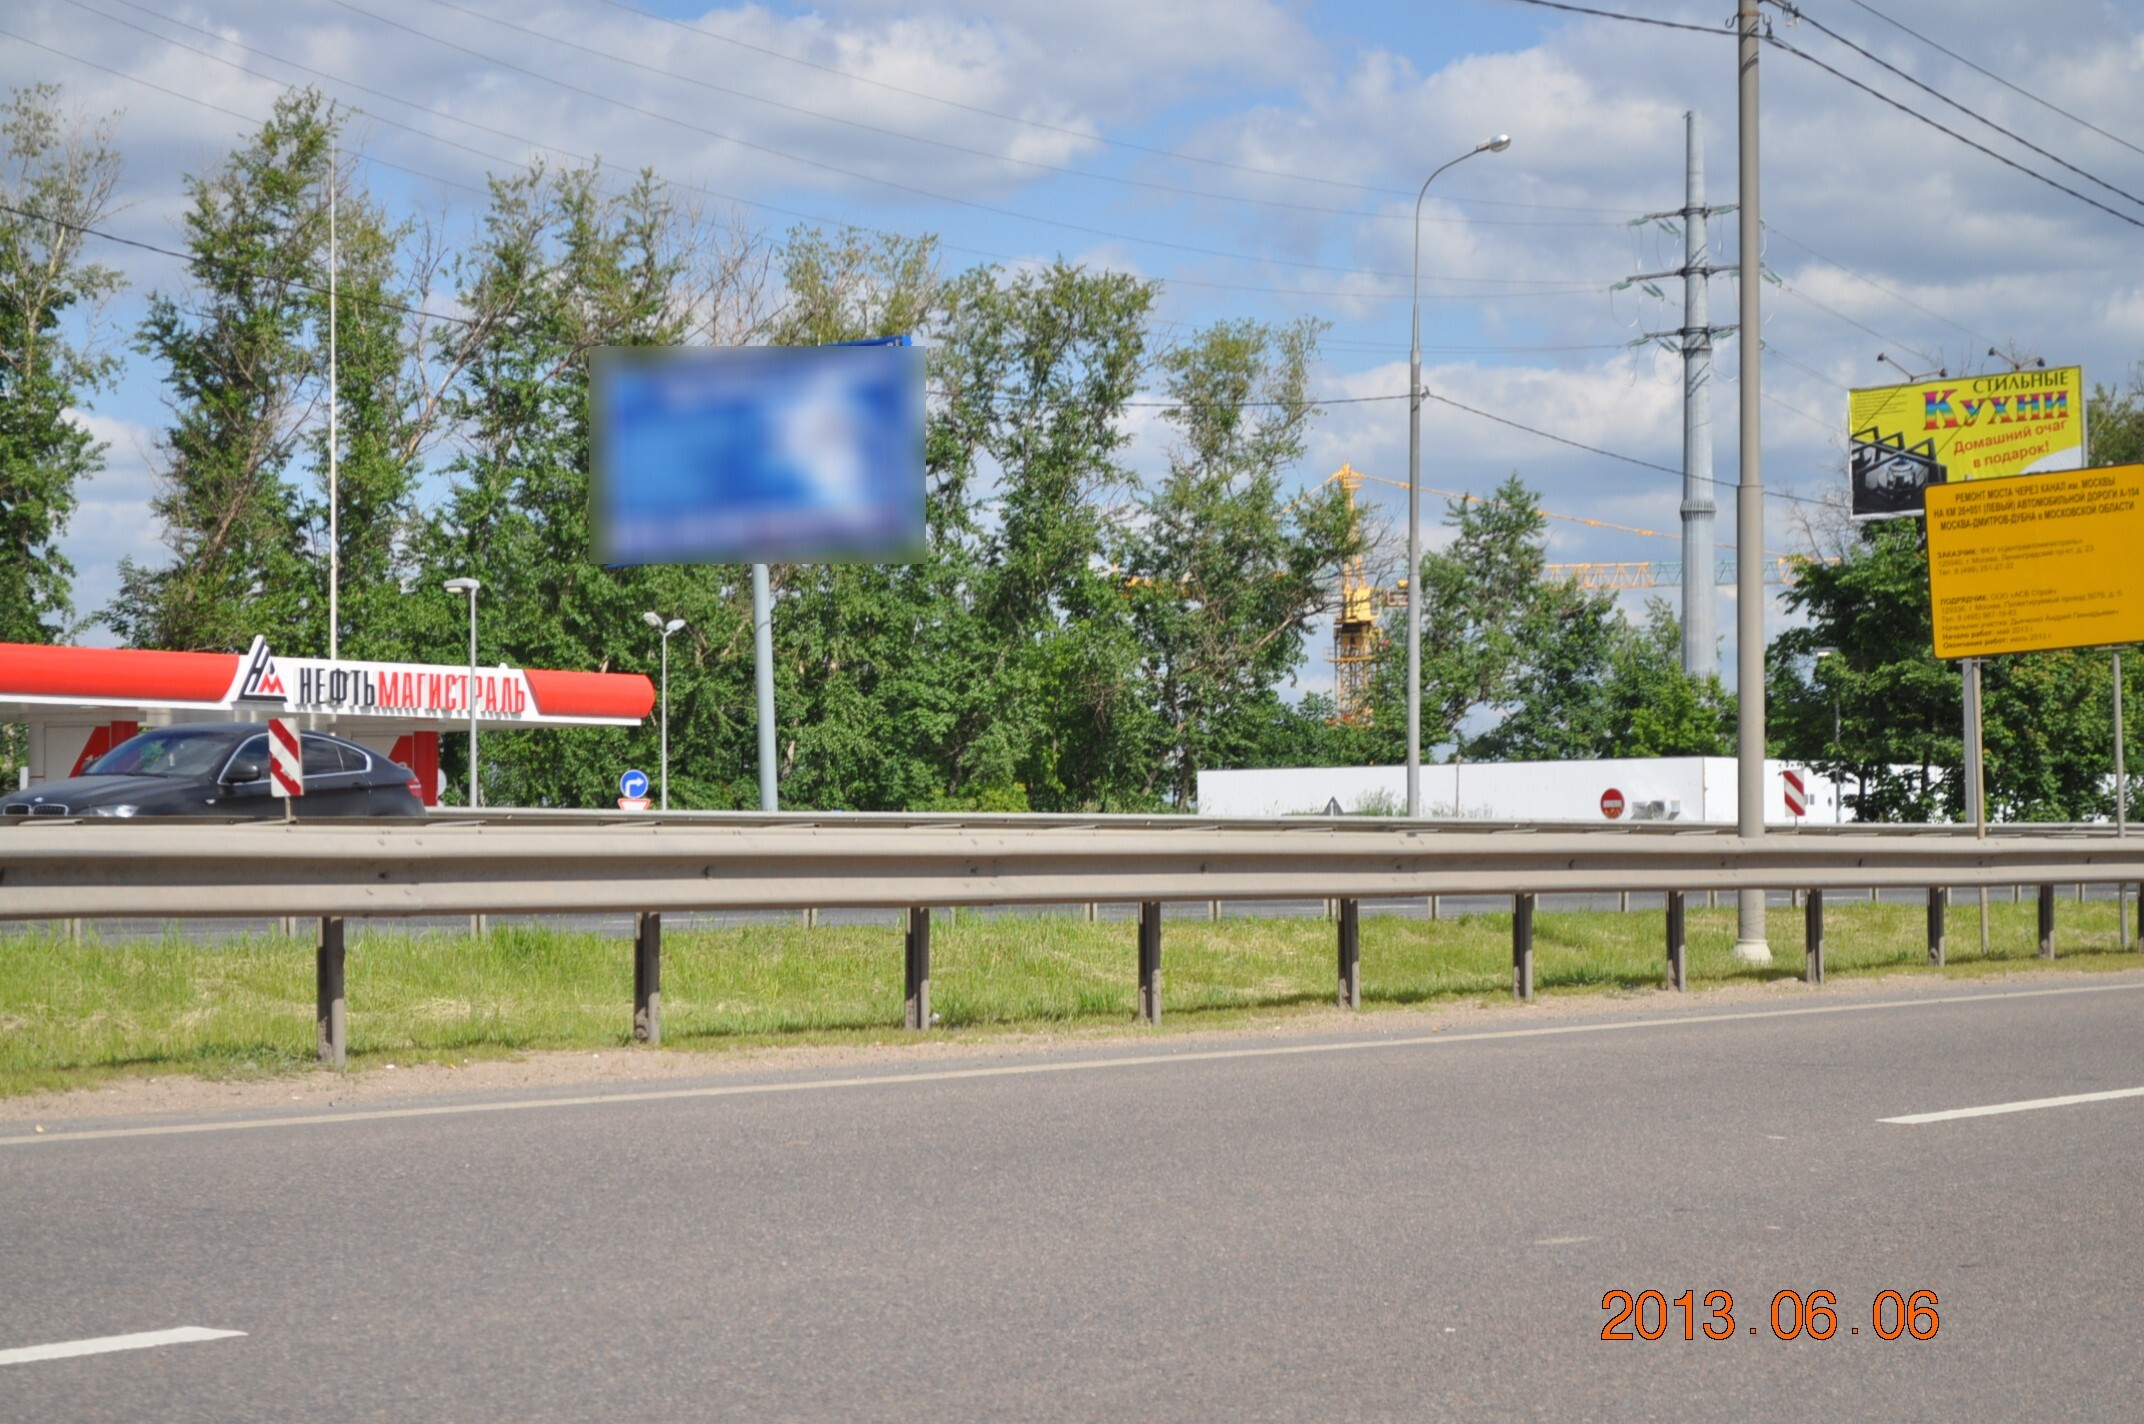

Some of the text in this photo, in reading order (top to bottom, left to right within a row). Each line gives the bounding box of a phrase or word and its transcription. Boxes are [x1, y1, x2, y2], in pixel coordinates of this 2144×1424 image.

[1972, 371, 2068, 394] СТИЛЬНЫЕ
[1953, 419, 2067, 456] Домашний очаг
[1973, 440, 2050, 469] в подарок!
[1955, 490, 1986, 502] РЕМОНТ
[1987, 487, 2013, 499] МОСТА
[2015, 484, 2039, 496] ЧЕРЕЗ
[2041, 481, 2066, 493] КАНАЛ
[2082, 476, 2115, 488] МОСКВЫ
[1934, 508, 1944, 518] НА
[1946, 507, 1956, 517] КМ
[2017, 493, 2085, 509] АВТОМОБИЛЬНОЙ
[2087, 489, 2117, 502] ДОРОГИ
[2044, 505, 2097, 519] МОСКОВСКОЙ
[2098, 500, 2134, 513] ОБЛАСТИ
